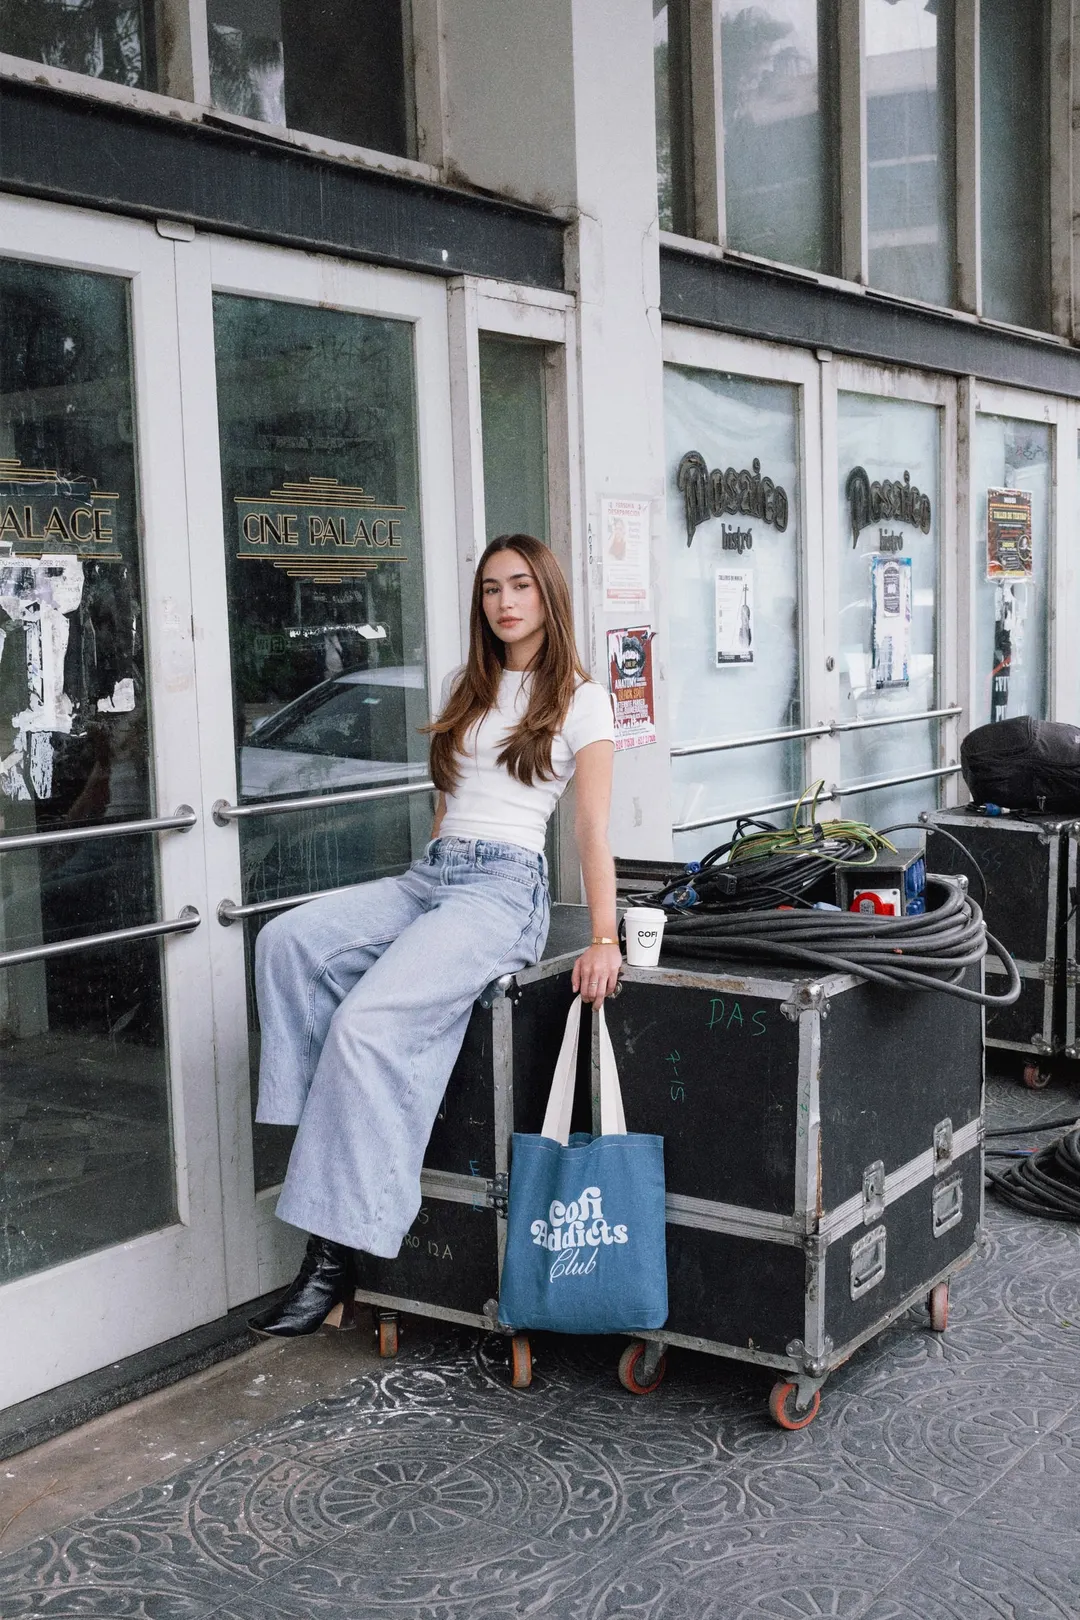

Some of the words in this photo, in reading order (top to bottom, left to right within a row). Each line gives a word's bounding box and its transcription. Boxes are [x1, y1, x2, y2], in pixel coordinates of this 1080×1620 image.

[676, 450, 789, 548] Mosaico
[845, 465, 931, 549] Mosaico
[0, 504, 113, 543] ALACE
[243, 513, 298, 546] CINE
[308, 516, 401, 547] PALACE
[721, 523, 753, 555] bistró
[879, 528, 904, 555] bistró
[637, 930, 658, 938] COFI
[705, 998, 767, 1037] DAS
[530, 1219, 629, 1251] Addicts
[550, 1248, 599, 1284] Club
